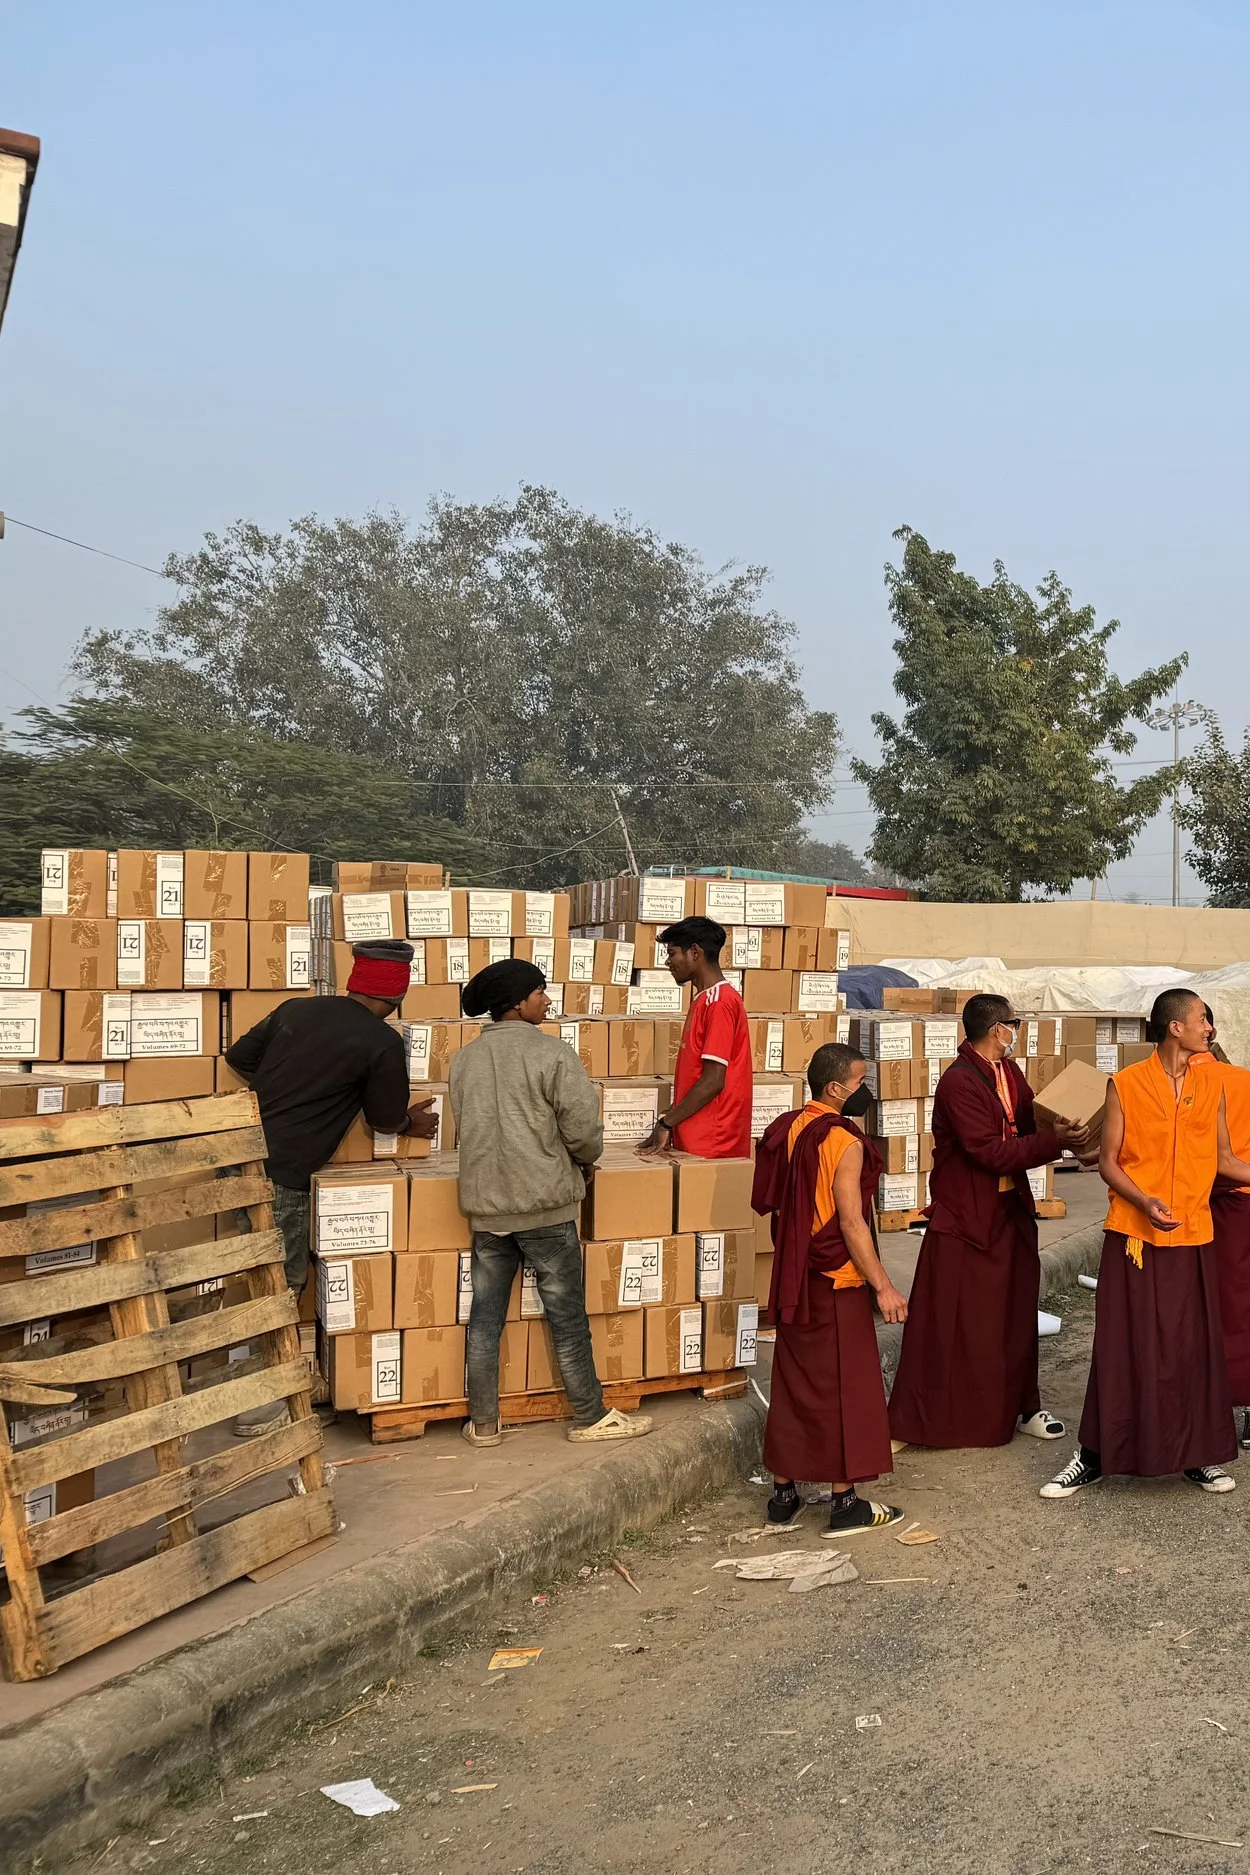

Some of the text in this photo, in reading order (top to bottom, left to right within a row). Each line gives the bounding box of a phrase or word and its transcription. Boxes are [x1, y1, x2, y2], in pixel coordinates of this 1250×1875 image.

[46, 867, 62, 880] 21
[163, 890, 180, 902] 21
[122, 937, 138, 950] 21
[188, 938, 204, 950] 21
[737, 948, 746, 956] 19
[840, 952, 848, 960] 19
[292, 960, 308, 972] 21
[453, 962, 463, 971] 18
[574, 962, 584, 970] 18
[110, 1030, 125, 1042] 21
[771, 1048, 782, 1058] 22
[35, 1251, 80, 1264] Volumes 81-84
[642, 1256, 657, 1267] 22
[704, 1250, 718, 1262] 22
[329, 1280, 346, 1292] 22
[626, 1276, 641, 1288] 22
[686, 1343, 700, 1356] 22
[742, 1338, 756, 1350] 22
[379, 1370, 396, 1383] 22
